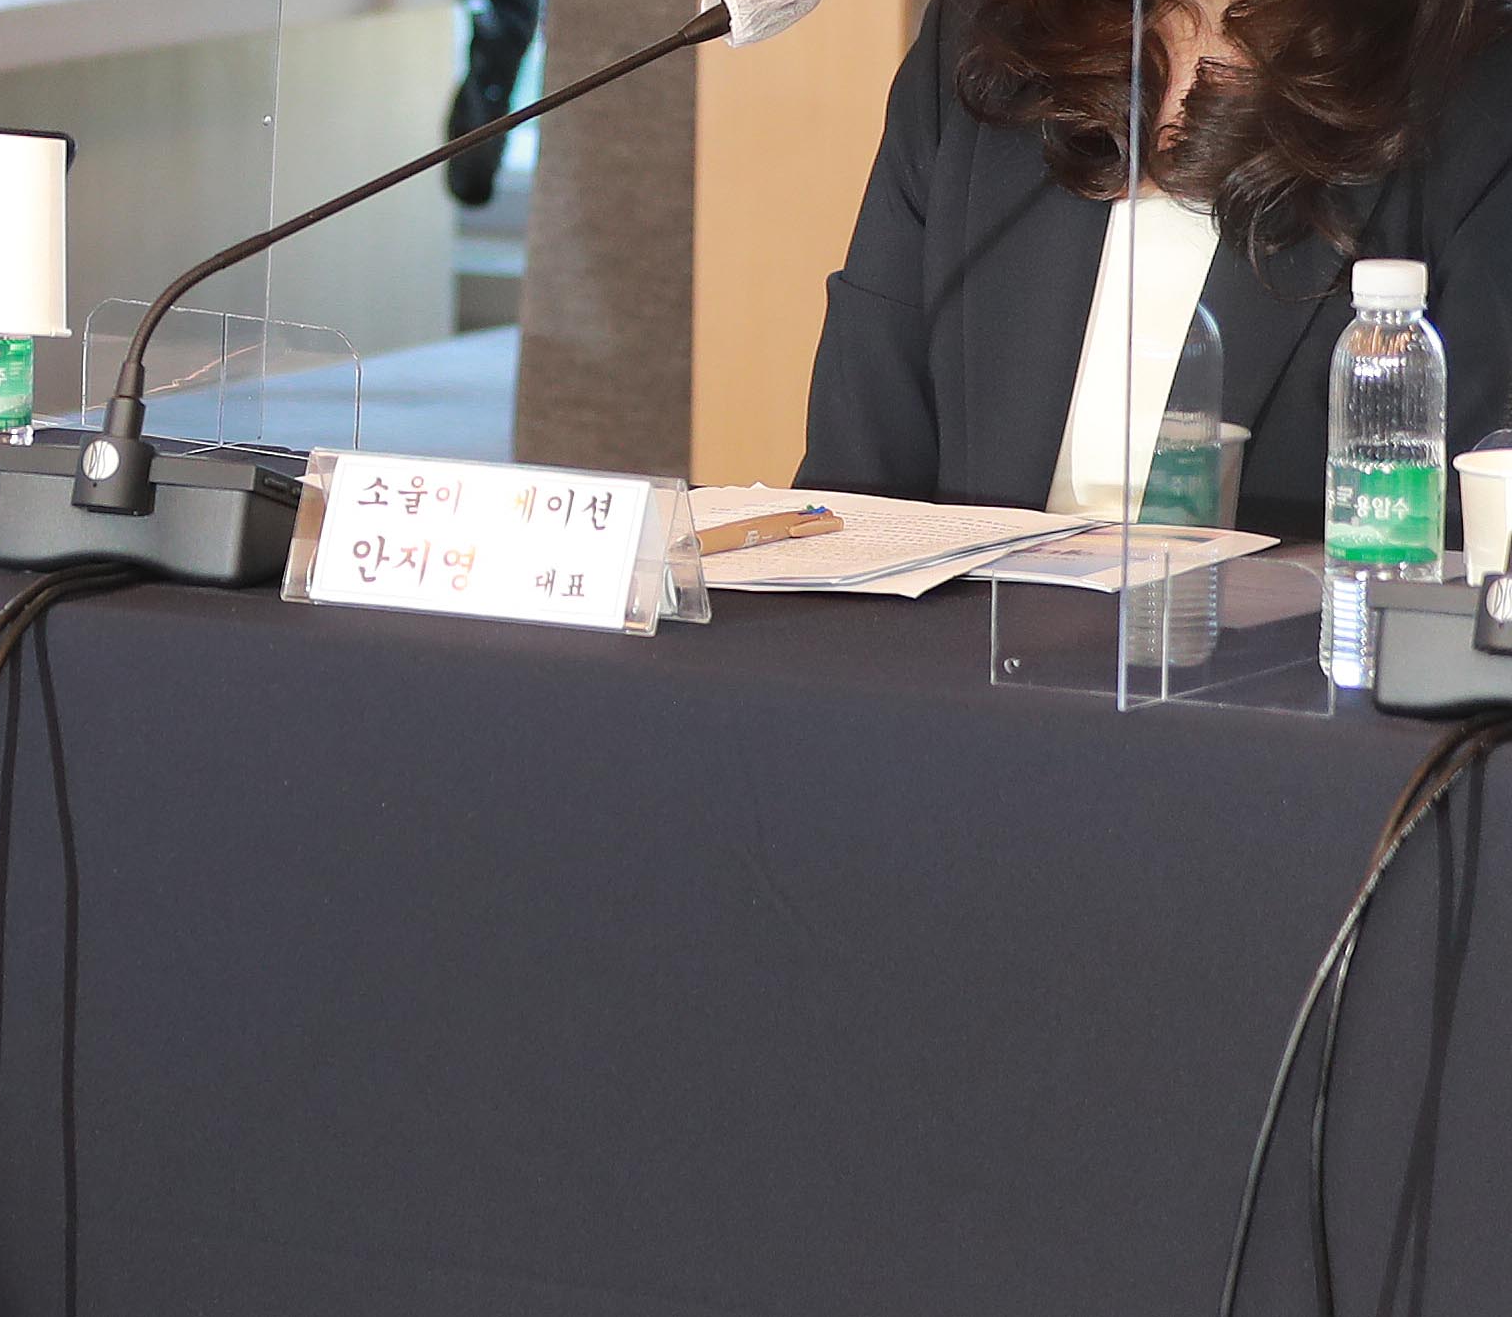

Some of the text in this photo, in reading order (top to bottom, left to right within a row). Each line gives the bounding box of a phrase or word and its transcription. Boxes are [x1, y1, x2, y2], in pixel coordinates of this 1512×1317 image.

[356, 474, 613, 532] 소울이이션
[1354, 495, 1410, 520] 용암수
[352, 535, 586, 600] 안지영 대표
